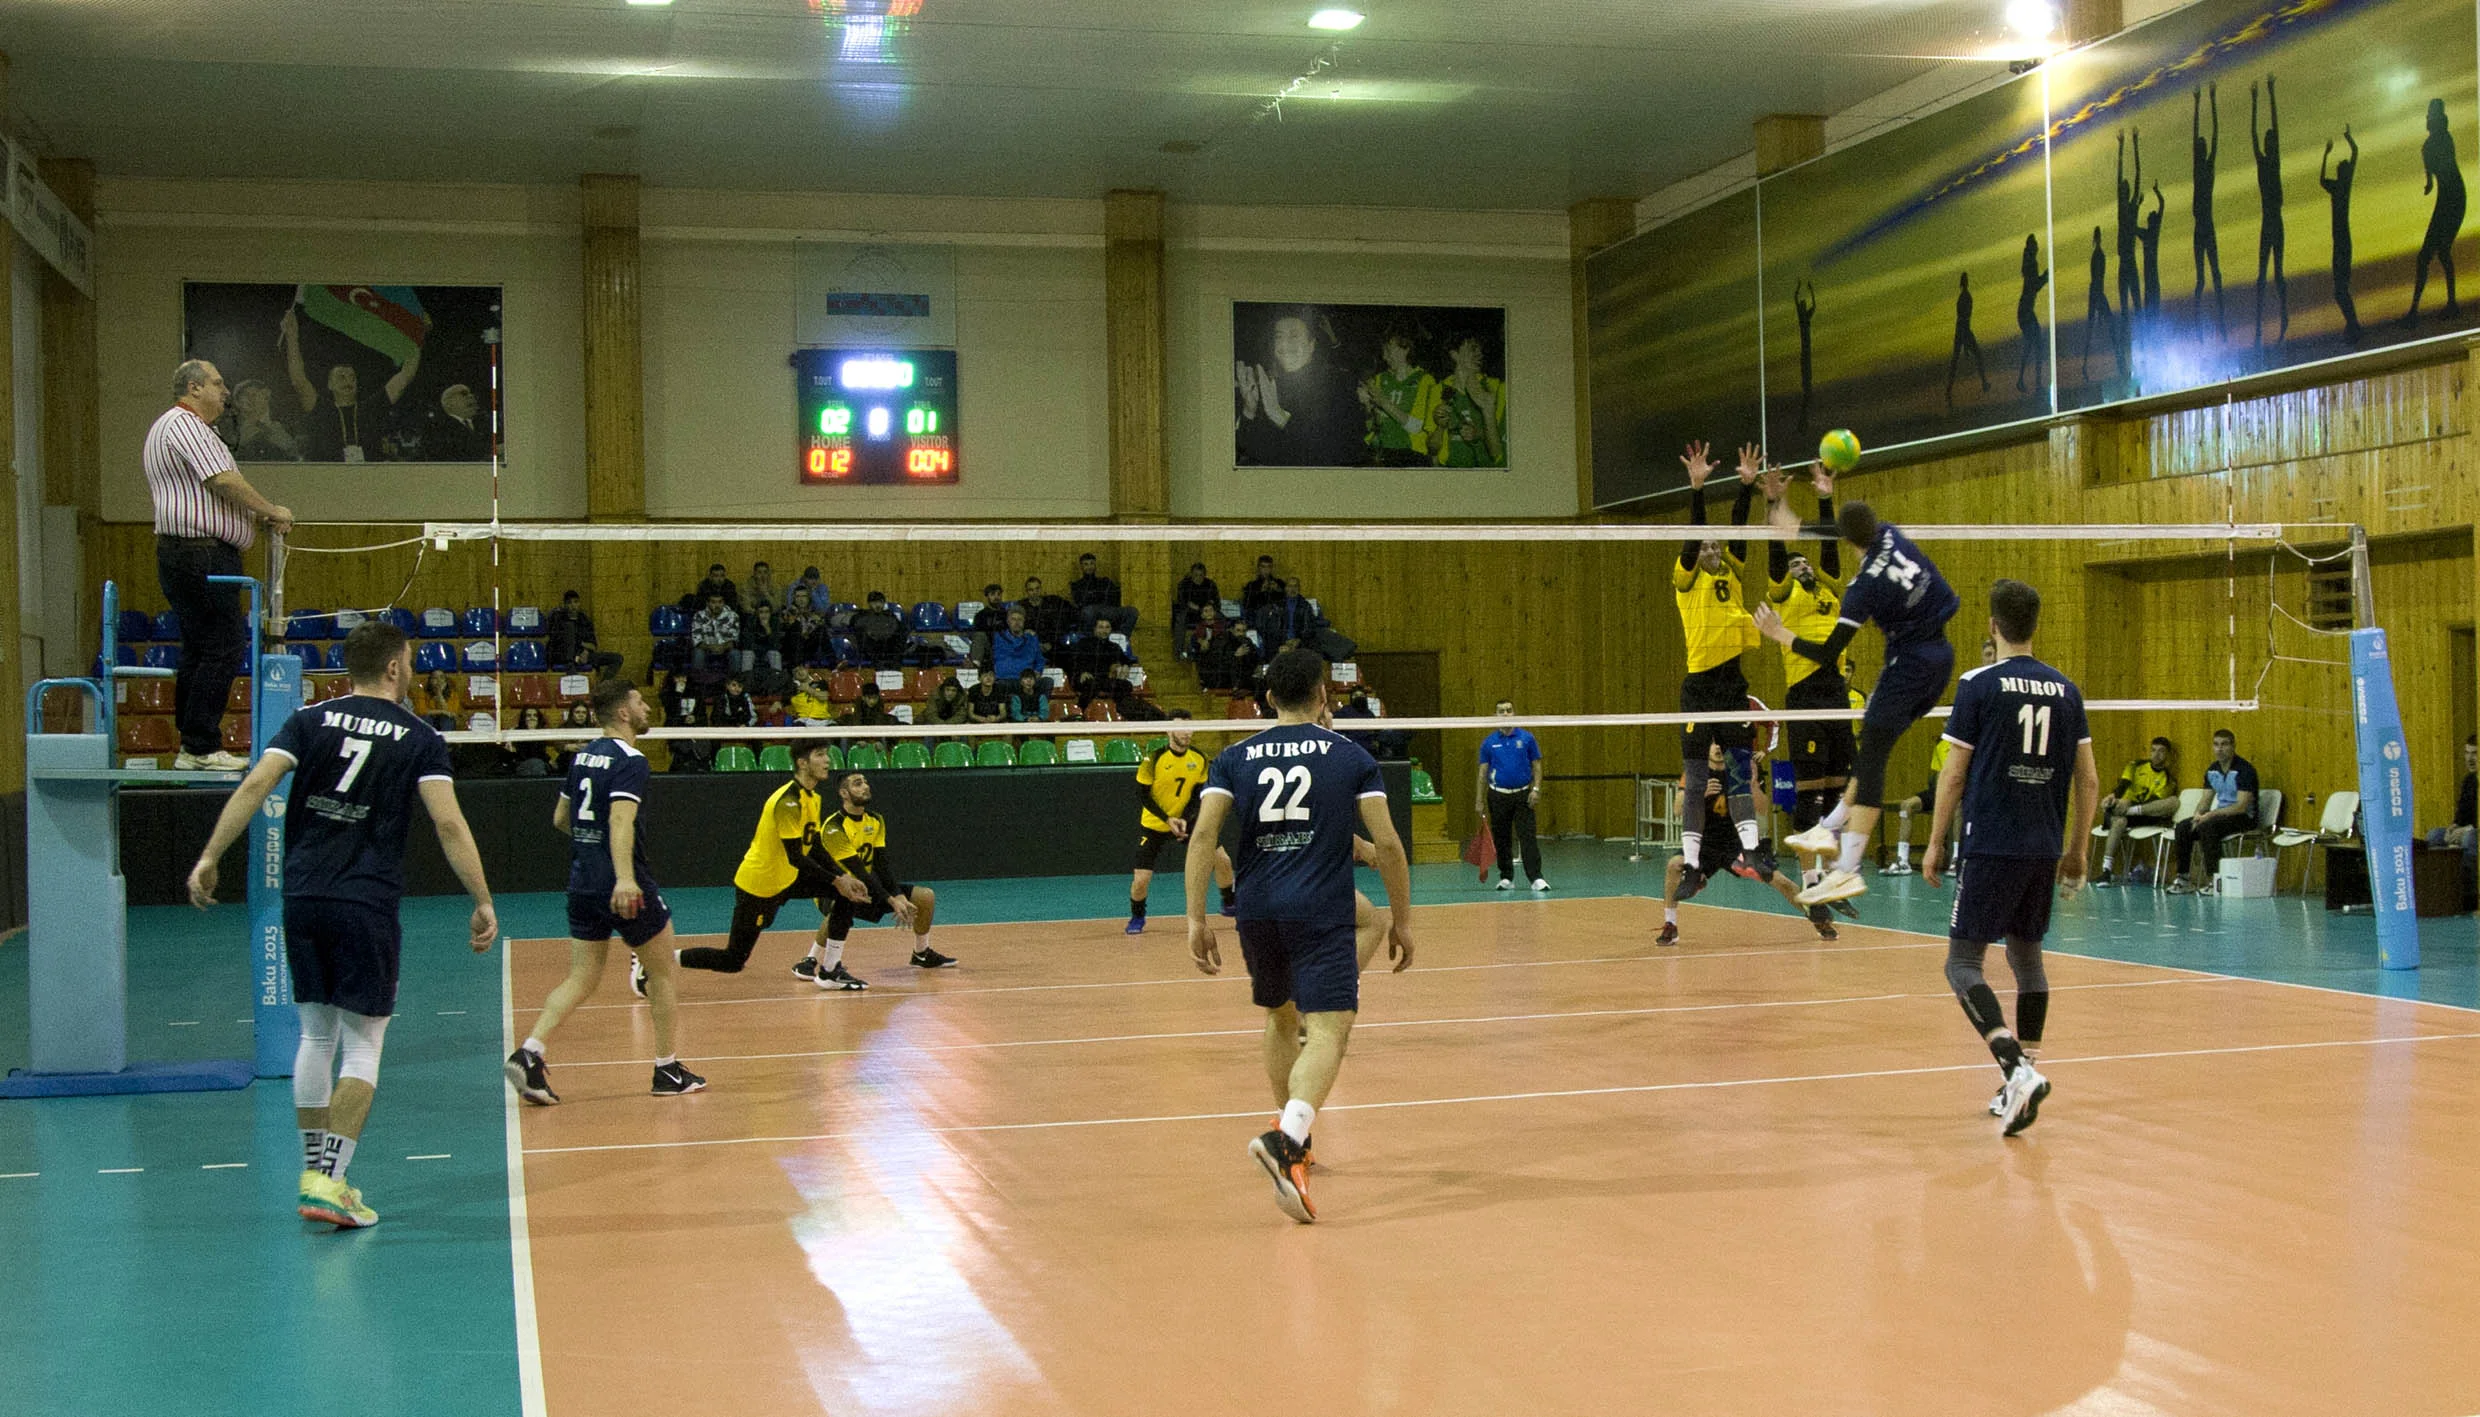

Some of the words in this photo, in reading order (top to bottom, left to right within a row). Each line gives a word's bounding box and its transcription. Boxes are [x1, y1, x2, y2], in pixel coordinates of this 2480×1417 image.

[820, 408, 851, 434] 02
[907, 409, 937, 434] 01
[811, 436, 850, 449] HOME
[911, 436, 949, 449] VISITOR
[810, 449, 850, 473] 012
[910, 449, 949, 473] 004
[1999, 677, 2065, 698] MUROV
[321, 710, 411, 741] MUROV
[2018, 703, 2051, 756] 11
[1246, 739, 1333, 761] MUROV
[338, 736, 373, 793] 7
[577, 777, 595, 821] 2
[1174, 777, 1186, 797] 7
[1257, 765, 1312, 823] 22
[803, 821, 817, 846] 6
[265, 827, 281, 889] senon
[264, 925, 279, 961] 2015
[262, 965, 278, 1006] Baku
